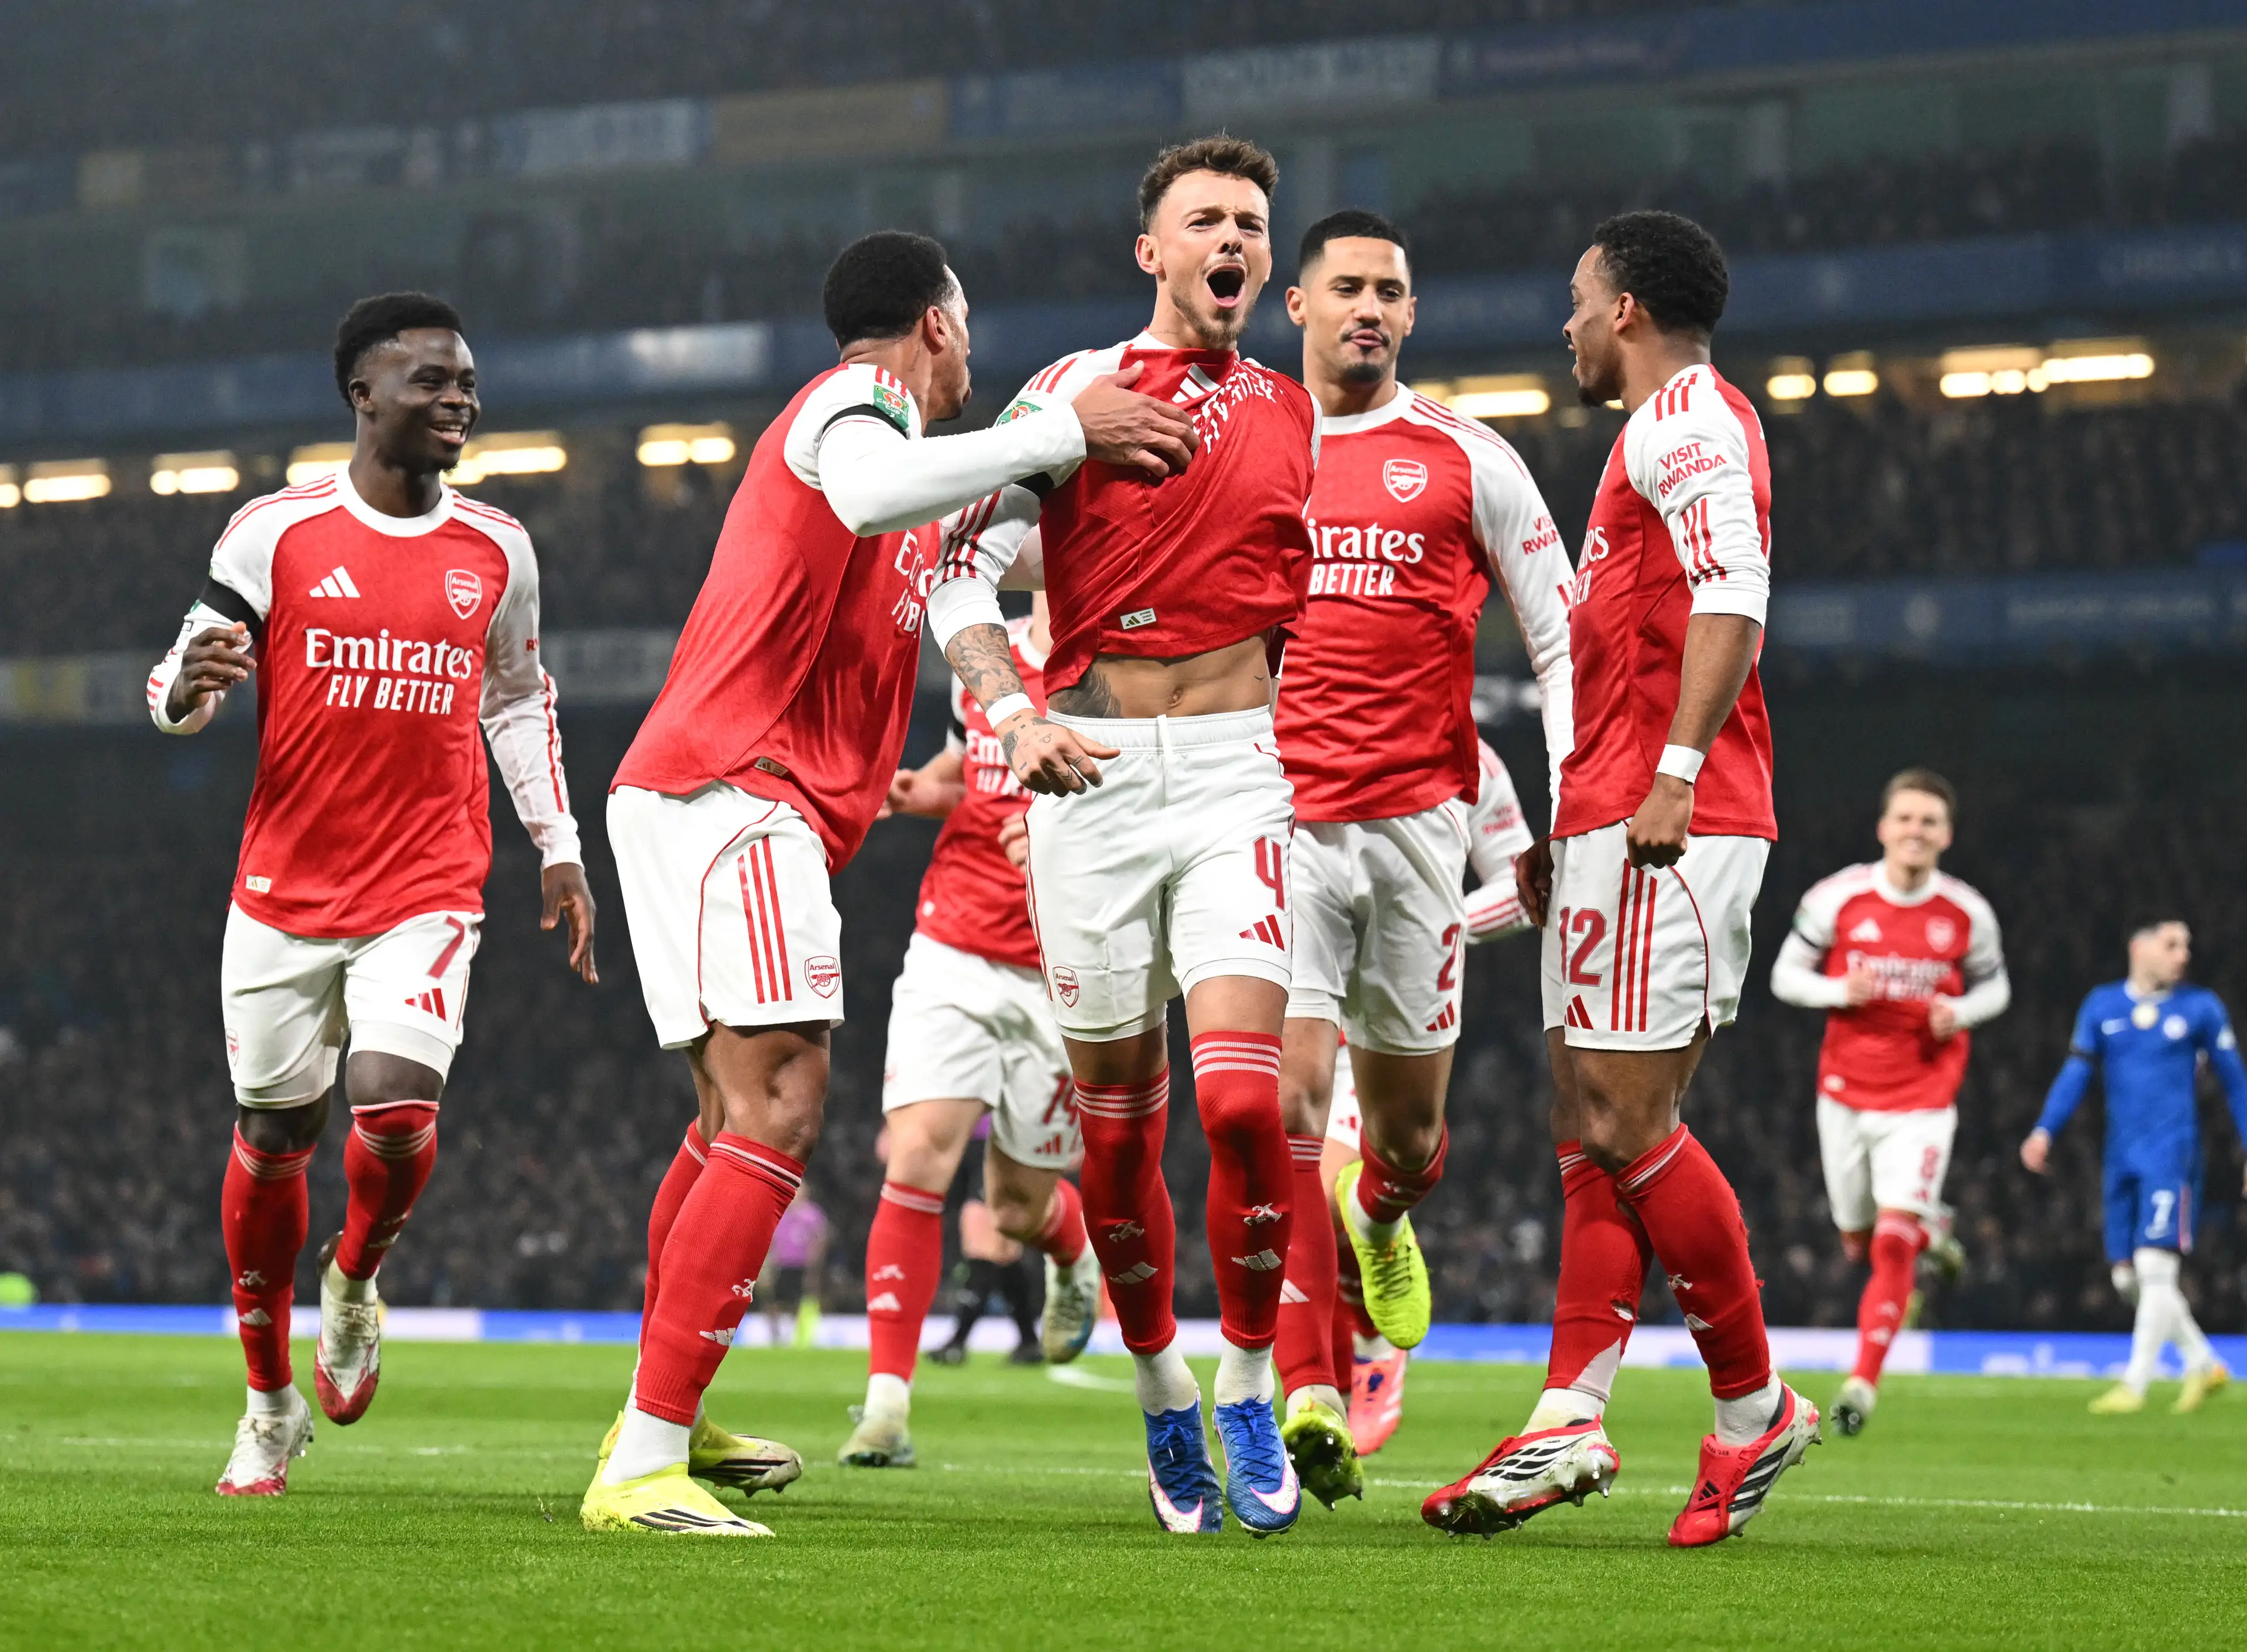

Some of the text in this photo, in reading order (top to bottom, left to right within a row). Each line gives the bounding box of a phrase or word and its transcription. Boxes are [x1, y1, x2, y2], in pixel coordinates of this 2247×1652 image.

[1658, 454, 1727, 499] RWANDA
[1660, 442, 1701, 470] VISIT
[1307, 518, 1425, 564] irates
[1533, 514, 1552, 532] VIS
[1308, 563, 1395, 596] BETTER
[305, 628, 473, 679] Emirates
[326, 674, 455, 715] FLY BETTER
[1252, 834, 1286, 913] 4
[425, 914, 465, 980] 7
[809, 963, 835, 971] Arsenal
[1437, 922, 1461, 992] 2
[1559, 906, 1607, 987] 12
[1056, 973, 1074, 982] Arsenal
